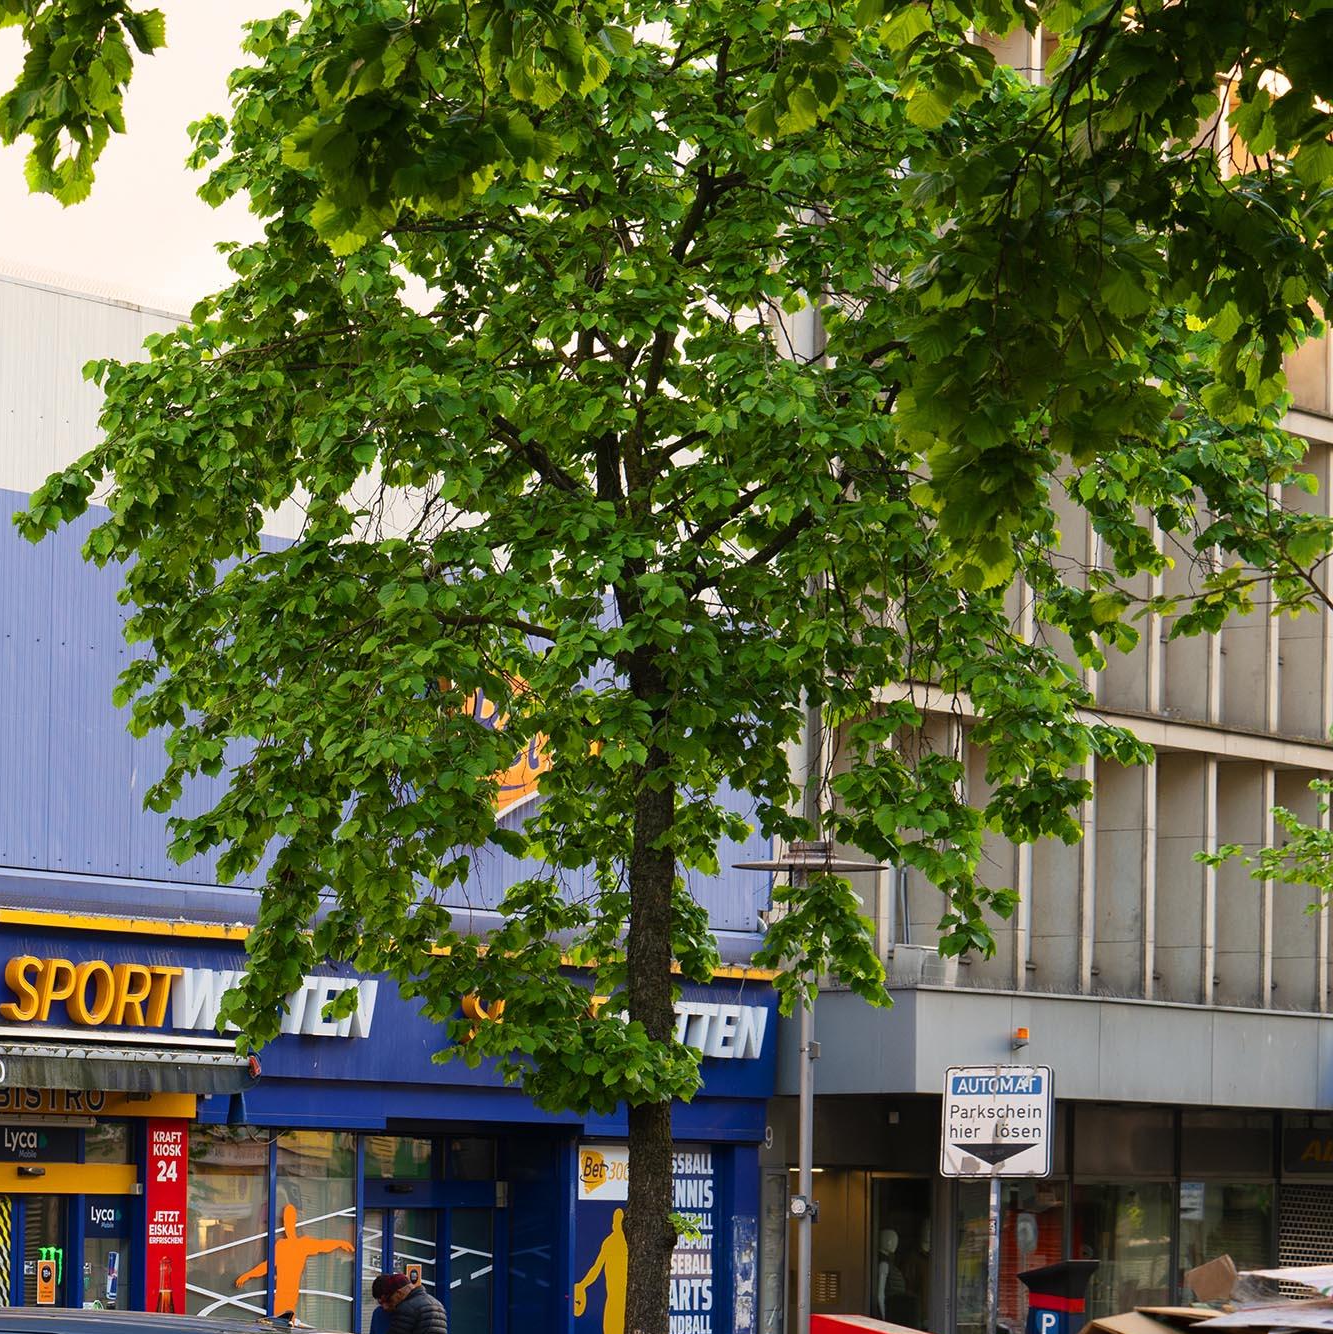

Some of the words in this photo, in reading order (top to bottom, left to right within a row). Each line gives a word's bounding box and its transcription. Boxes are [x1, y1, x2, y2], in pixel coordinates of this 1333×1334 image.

[957, 1078, 1037, 1093] AUTOMAT
[950, 1104, 1042, 1119] Parkschein
[153, 1131, 182, 1143] KRAFT
[765, 1126, 773, 1149] 9
[950, 1124, 980, 1138] hier
[994, 1124, 1041, 1138] lösen
[4, 1128, 37, 1152] Lyca
[153, 1143, 182, 1156] KIOSK
[156, 1160, 178, 1182] 24
[583, 1157, 605, 1178] Bet
[608, 1161, 630, 1180] 300
[91, 1206, 115, 1224] Lyca
[153, 1210, 180, 1222] JETZT
[148, 1224, 183, 1236] EISKALT
[669, 1279, 713, 1312] ARTS
